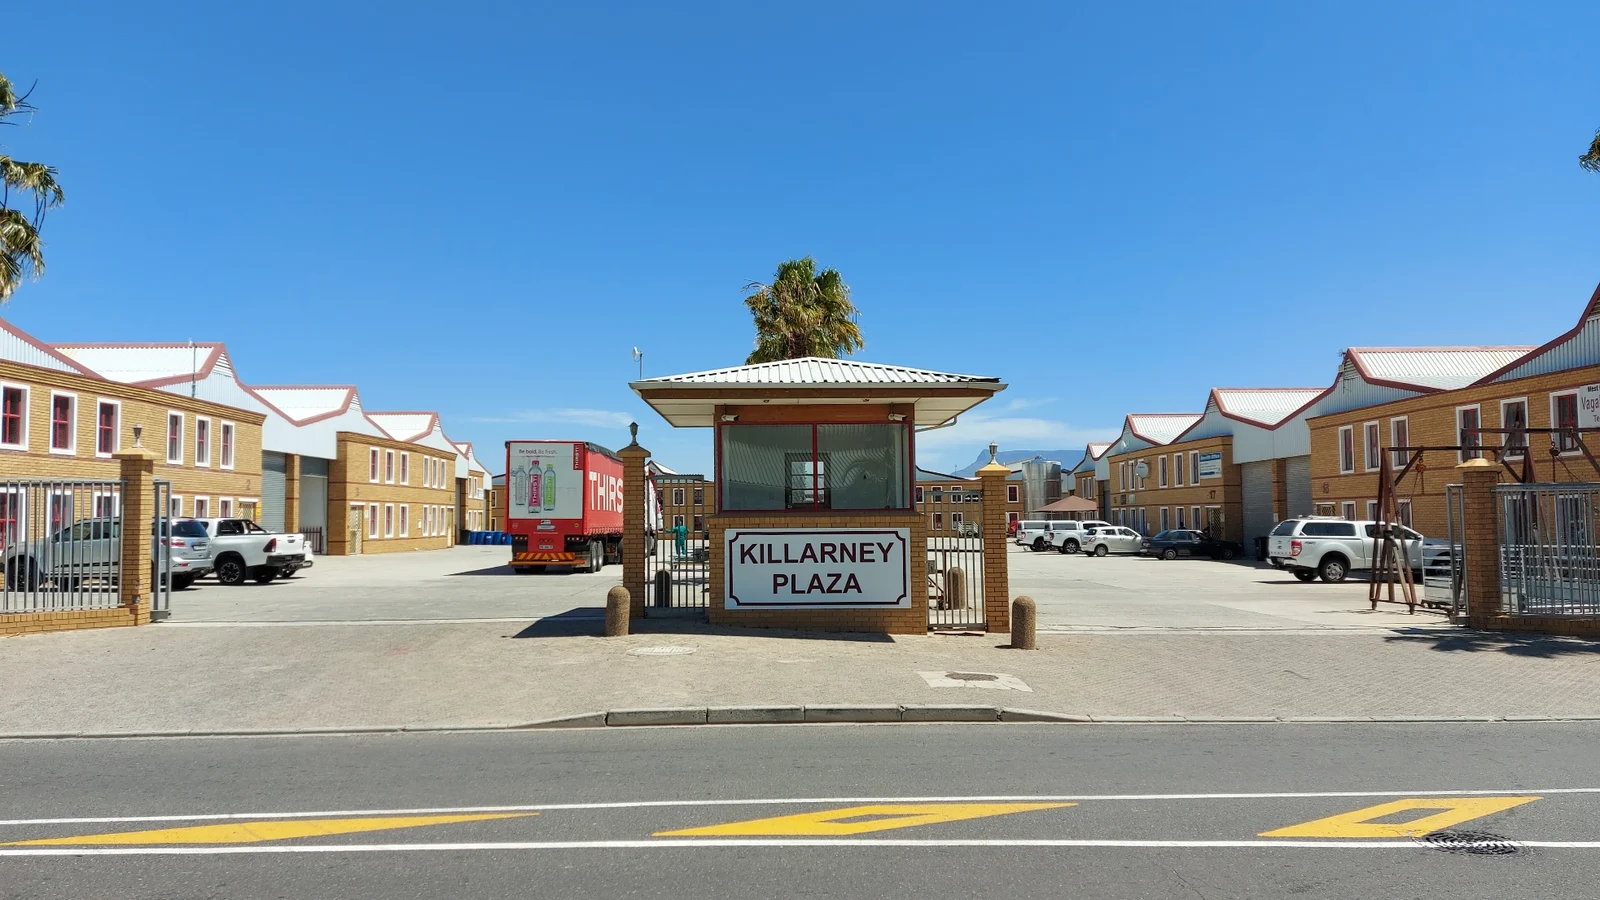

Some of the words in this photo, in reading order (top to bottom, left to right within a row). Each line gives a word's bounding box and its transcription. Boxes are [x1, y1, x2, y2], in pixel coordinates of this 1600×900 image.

[1581, 396, 1600, 412] Vaga
[589, 471, 624, 514] THIRS
[740, 542, 894, 564] KILLARNEY
[773, 573, 863, 594] PLAZA
